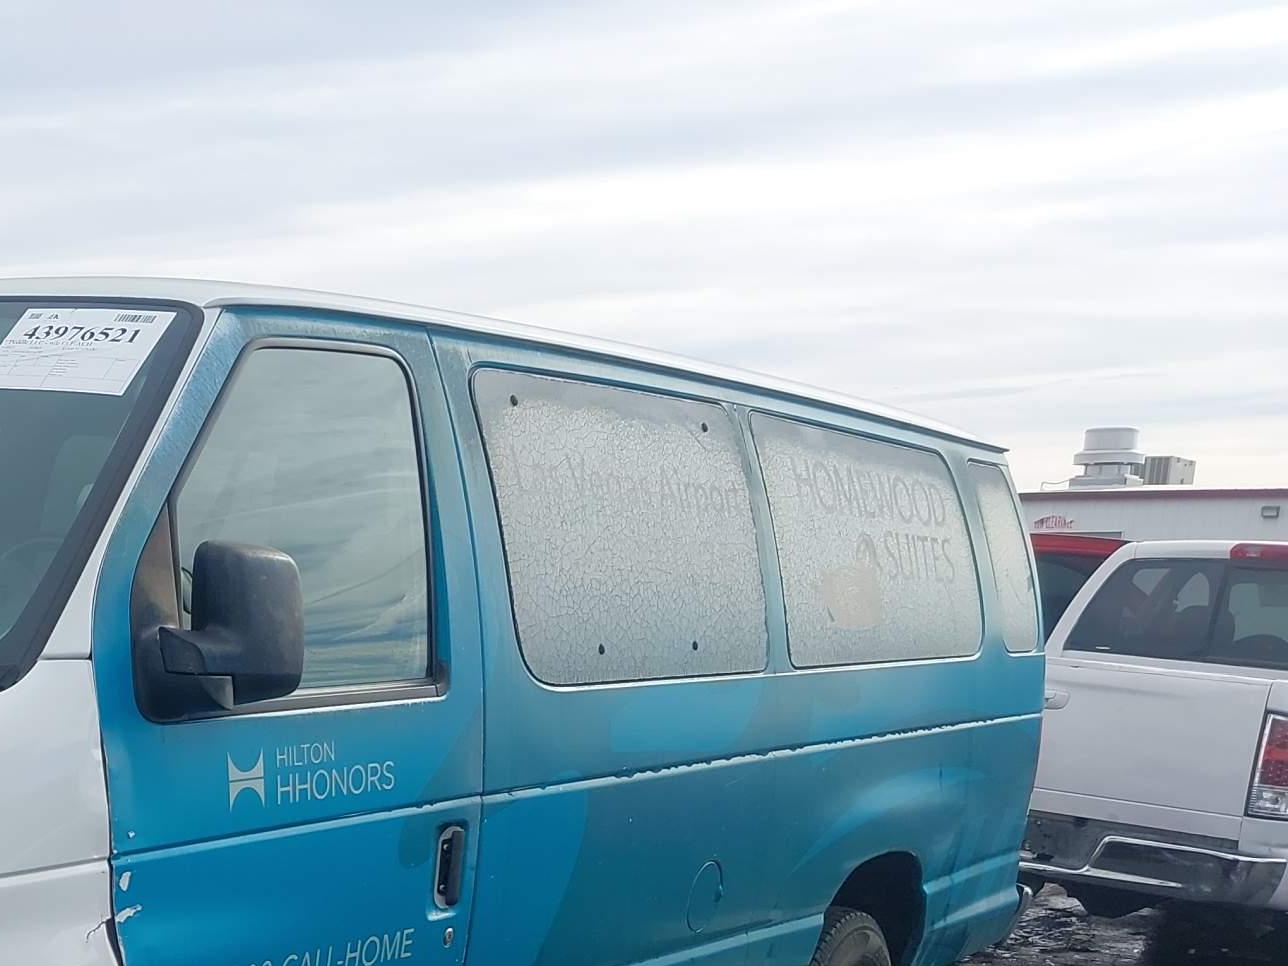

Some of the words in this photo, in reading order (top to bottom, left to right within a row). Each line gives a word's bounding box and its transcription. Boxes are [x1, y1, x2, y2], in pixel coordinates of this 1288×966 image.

[23, 325, 141, 344] 43976521
[790, 457, 947, 527] HOMEWOOD
[883, 531, 956, 584] SUITES
[276, 741, 336, 768] HILTON
[277, 761, 396, 805] HHONORS
